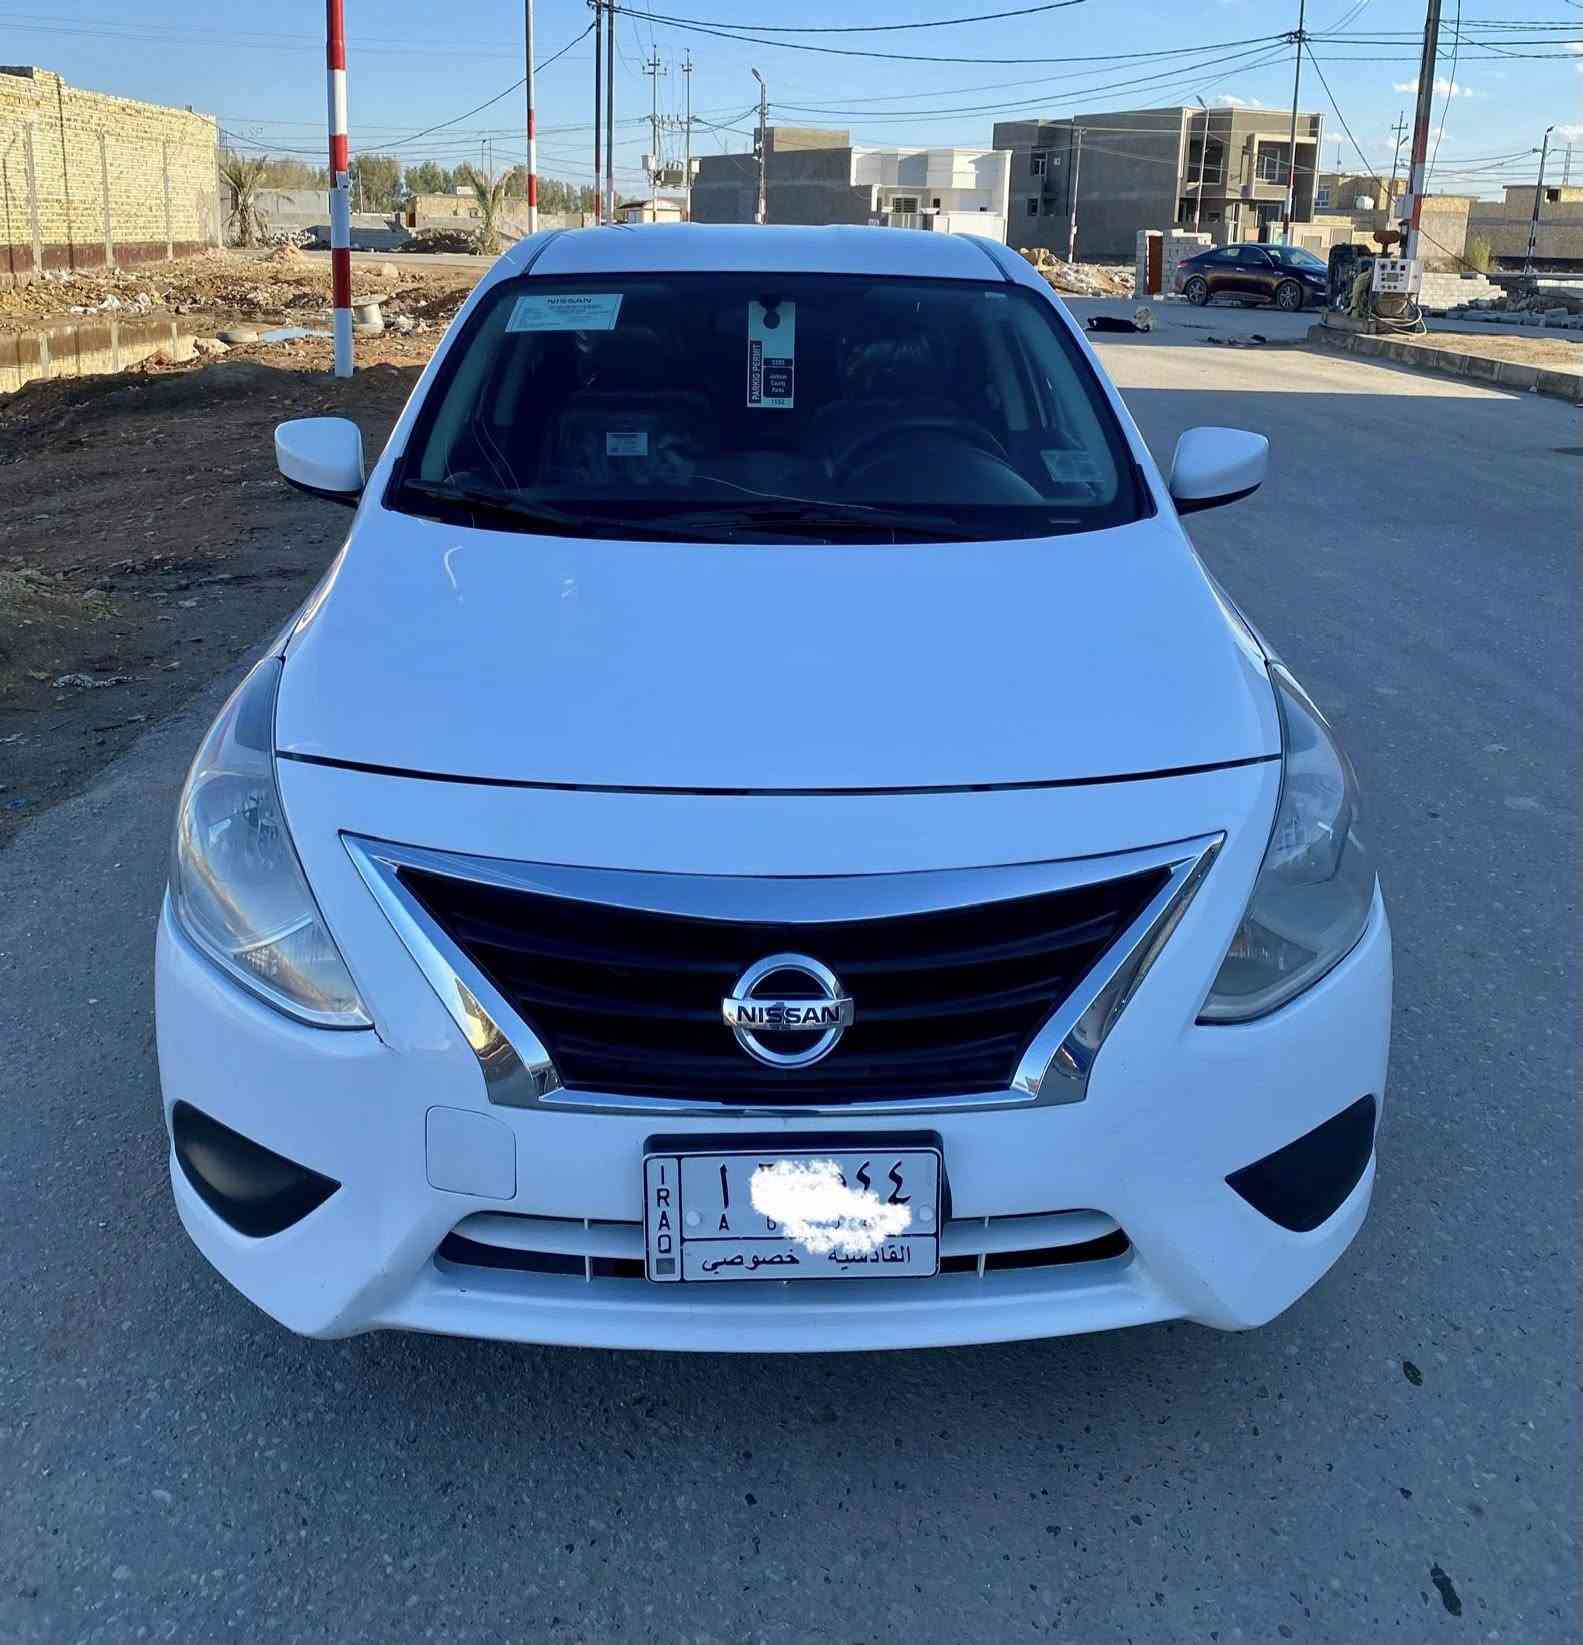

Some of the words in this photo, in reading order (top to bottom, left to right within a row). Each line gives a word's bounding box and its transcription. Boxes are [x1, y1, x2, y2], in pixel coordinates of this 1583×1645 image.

[546, 296, 593, 304] NISSAN
[752, 343, 761, 372] PERMIT
[737, 1005, 841, 1024] NISSAN
[656, 1165, 672, 1254] IRAQ
[702, 1248, 800, 1275] خصوصي
